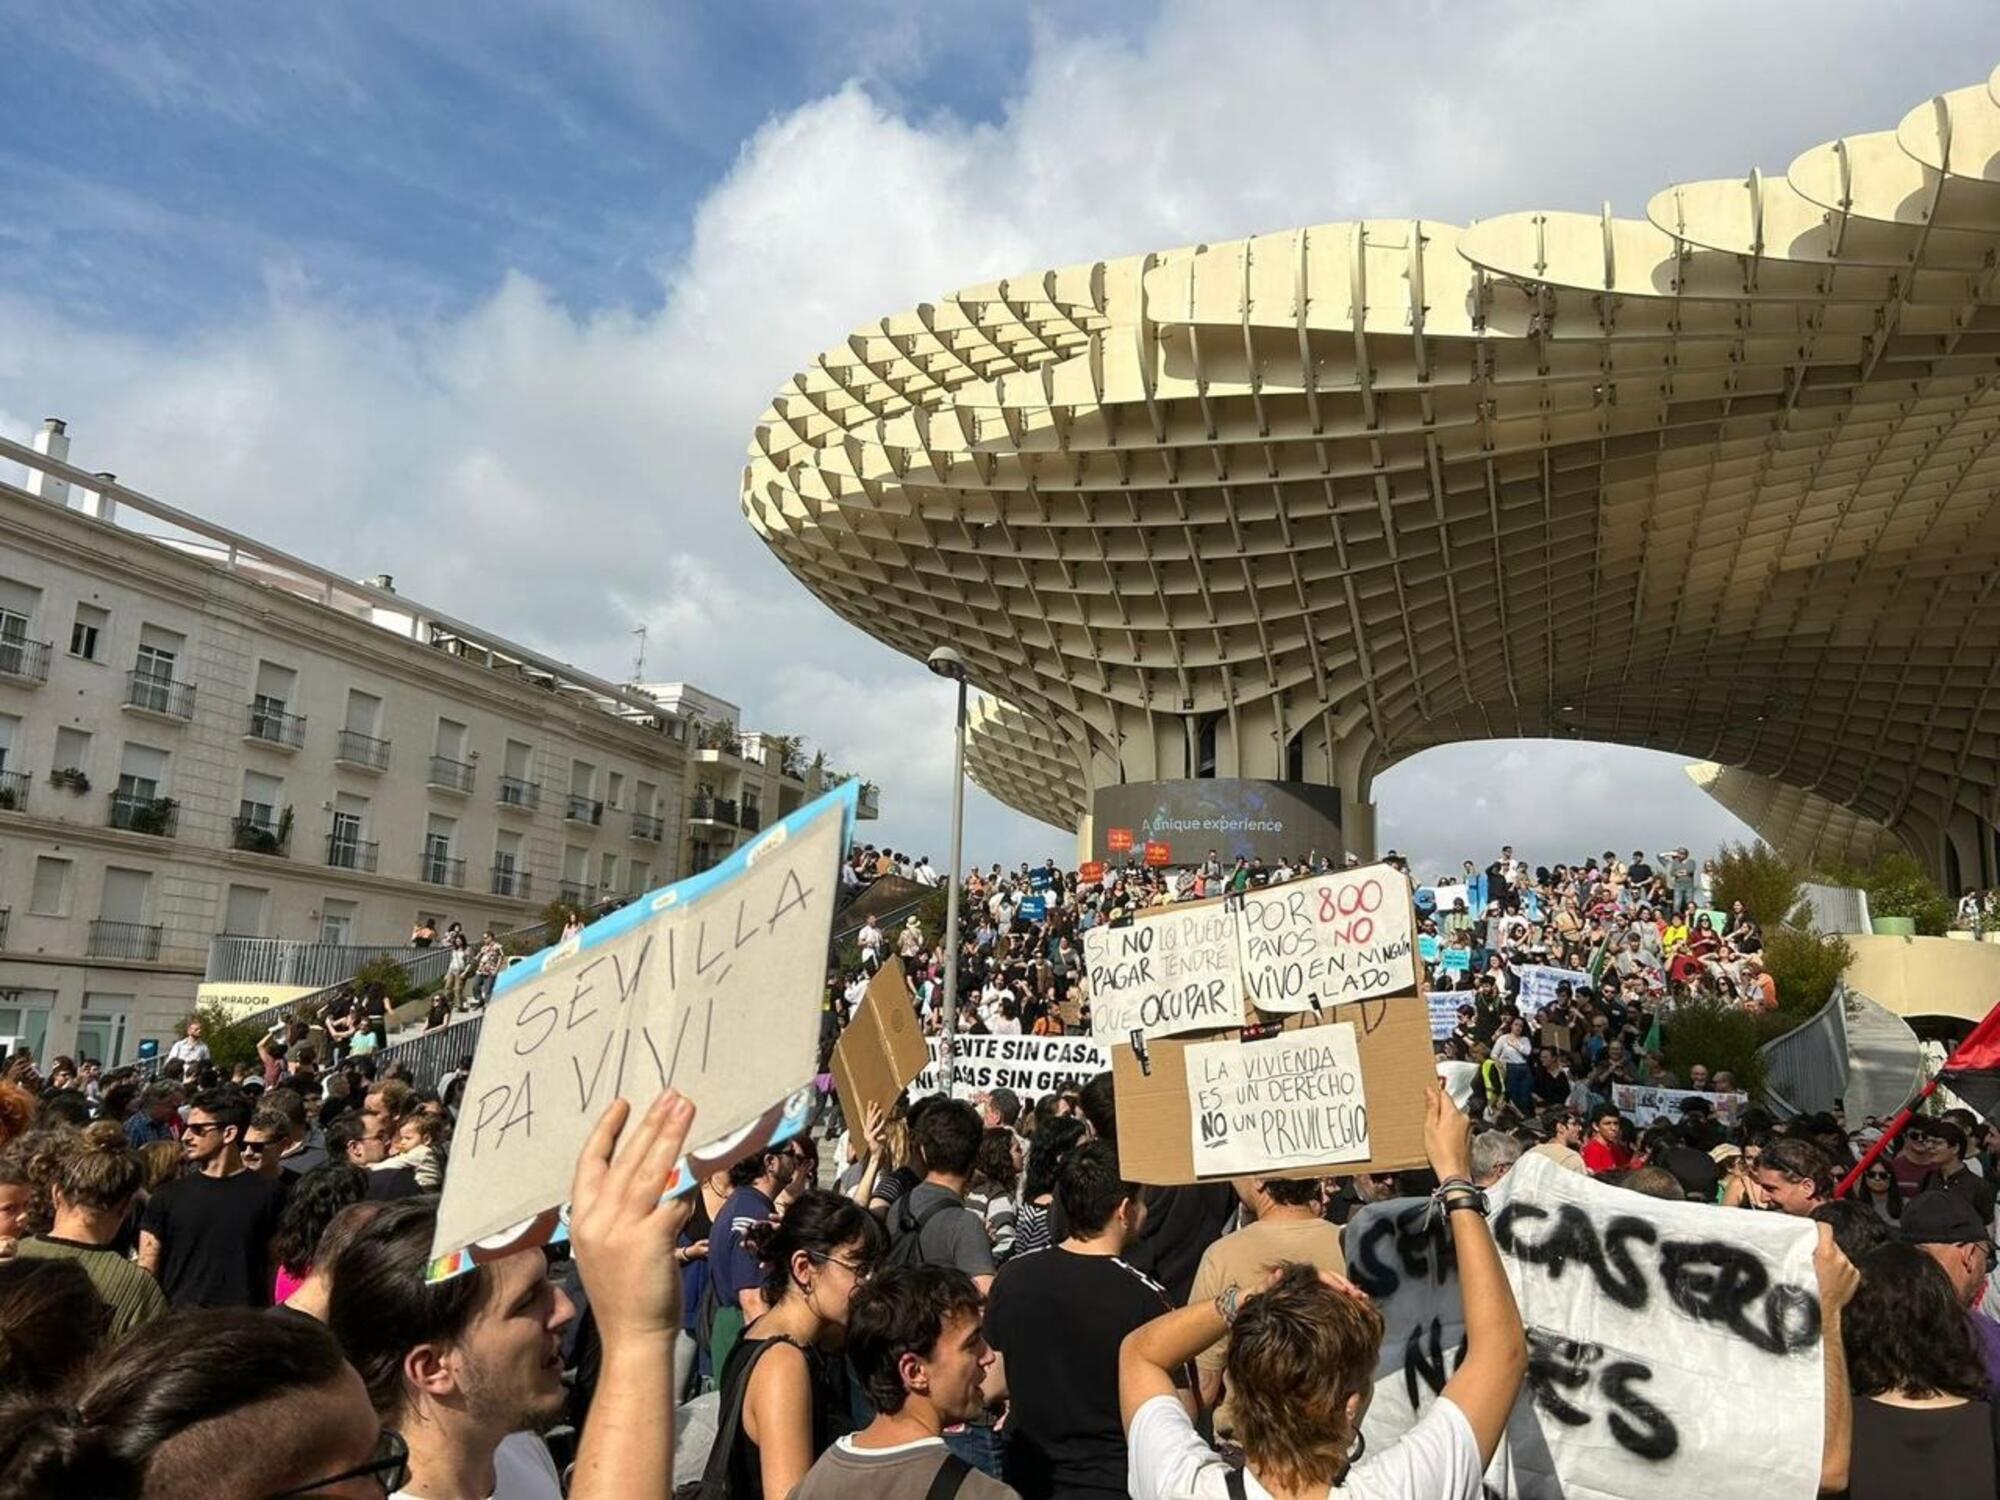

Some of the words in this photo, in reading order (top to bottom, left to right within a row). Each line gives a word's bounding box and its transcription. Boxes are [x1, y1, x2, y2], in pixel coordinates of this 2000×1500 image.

[1153, 818, 1200, 832] unique
[1203, 816, 1283, 833] experience
[1245, 891, 1313, 932] POR
[1318, 879, 1383, 922] 800
[1122, 926, 1154, 957] NO
[1159, 926, 1176, 951] LO
[1183, 914, 1233, 947] PUEDO
[1248, 928, 1317, 962] PAVOS
[1334, 917, 1373, 947] NO
[513, 869, 813, 1056] SEVILLA
[1091, 957, 1155, 996] PAGAR
[1161, 943, 1229, 977] TENDRÉ
[1308, 953, 1346, 980] EN
[1322, 969, 1390, 997] LADO
[1094, 1004, 1131, 1034] QUE
[951, 1037, 998, 1058] ENTE
[1001, 1040, 1040, 1061] SIN
[1043, 1043, 1106, 1068] CASA,
[1204, 1057, 1229, 1083] LA
[1243, 1046, 1336, 1079] VIVIENDA
[996, 1069, 1032, 1089] SIN
[1198, 1087, 1223, 1110] ES
[1236, 1084, 1259, 1104] UN
[1269, 1072, 1355, 1102] DERECHO
[470, 1070, 537, 1160] PA
[1200, 1111, 1227, 1141] NO
[1233, 1114, 1256, 1132] UN
[1494, 1202, 1822, 1356] CASERO
[1405, 1317, 1468, 1410] N
